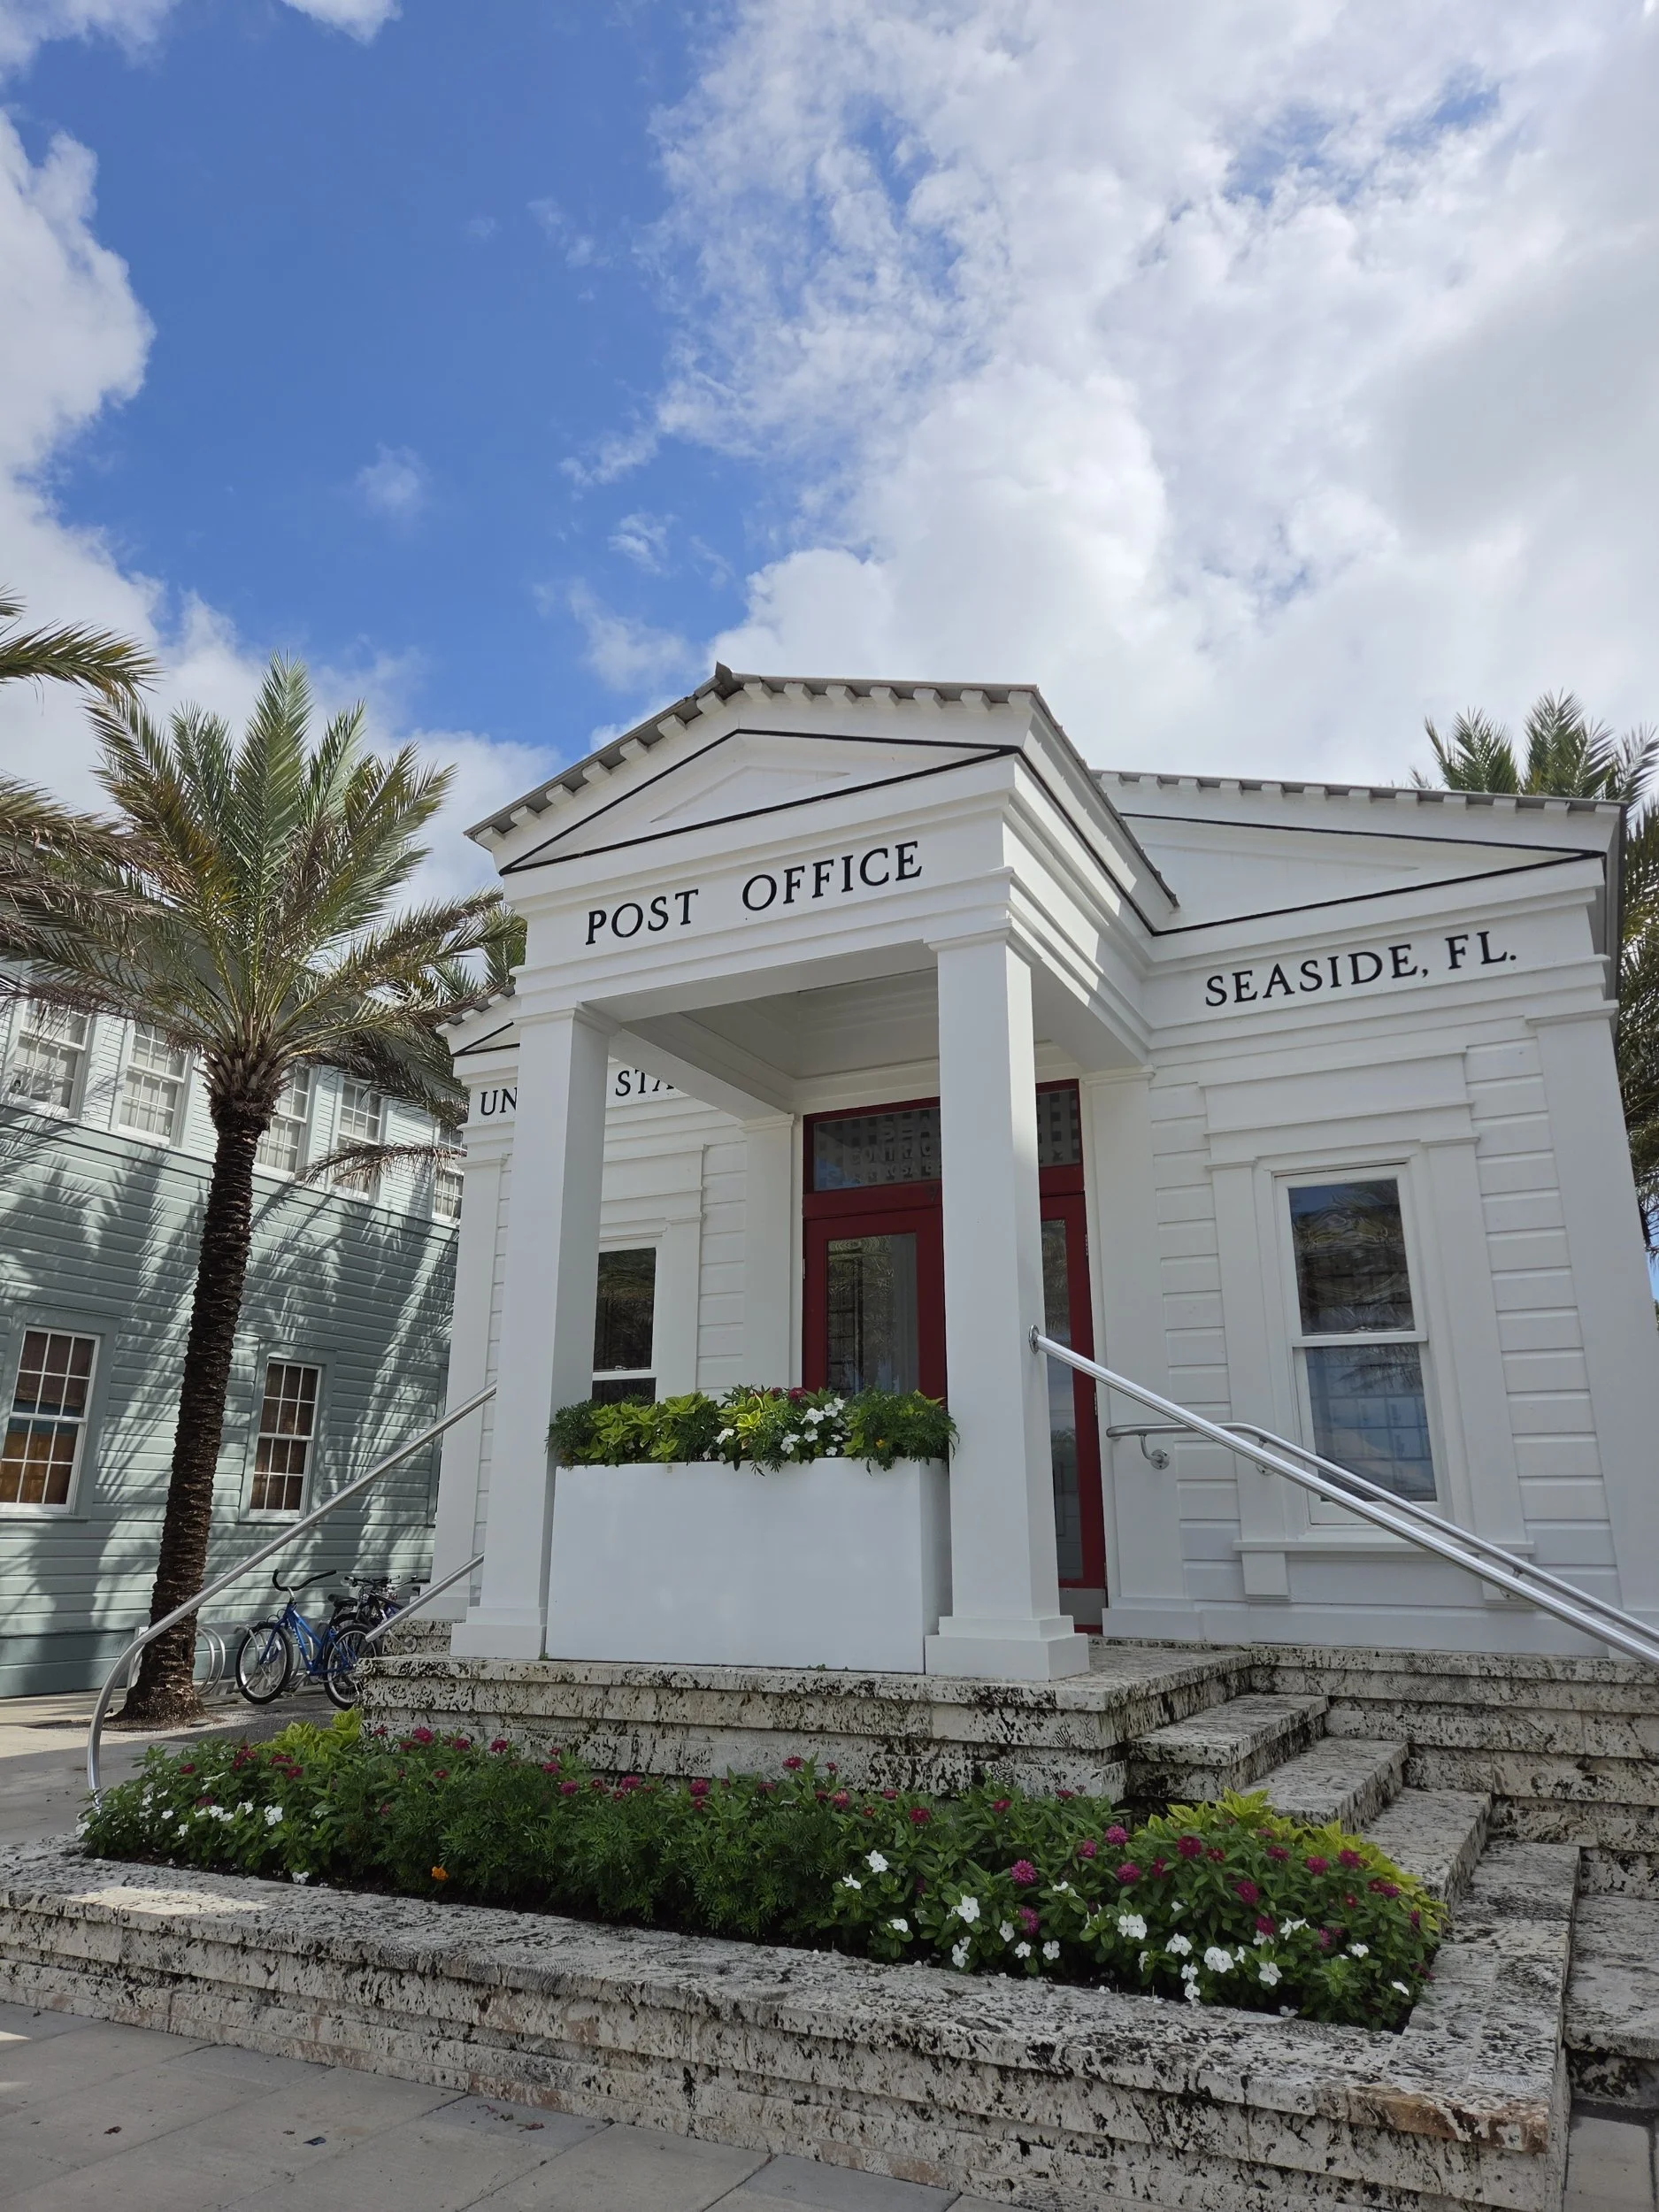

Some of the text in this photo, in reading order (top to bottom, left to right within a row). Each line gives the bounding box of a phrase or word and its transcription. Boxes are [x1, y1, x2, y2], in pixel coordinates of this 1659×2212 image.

[585, 841, 923, 945] POST OFFICE
[1205, 931, 1517, 1007] SEASIDE, FL.
